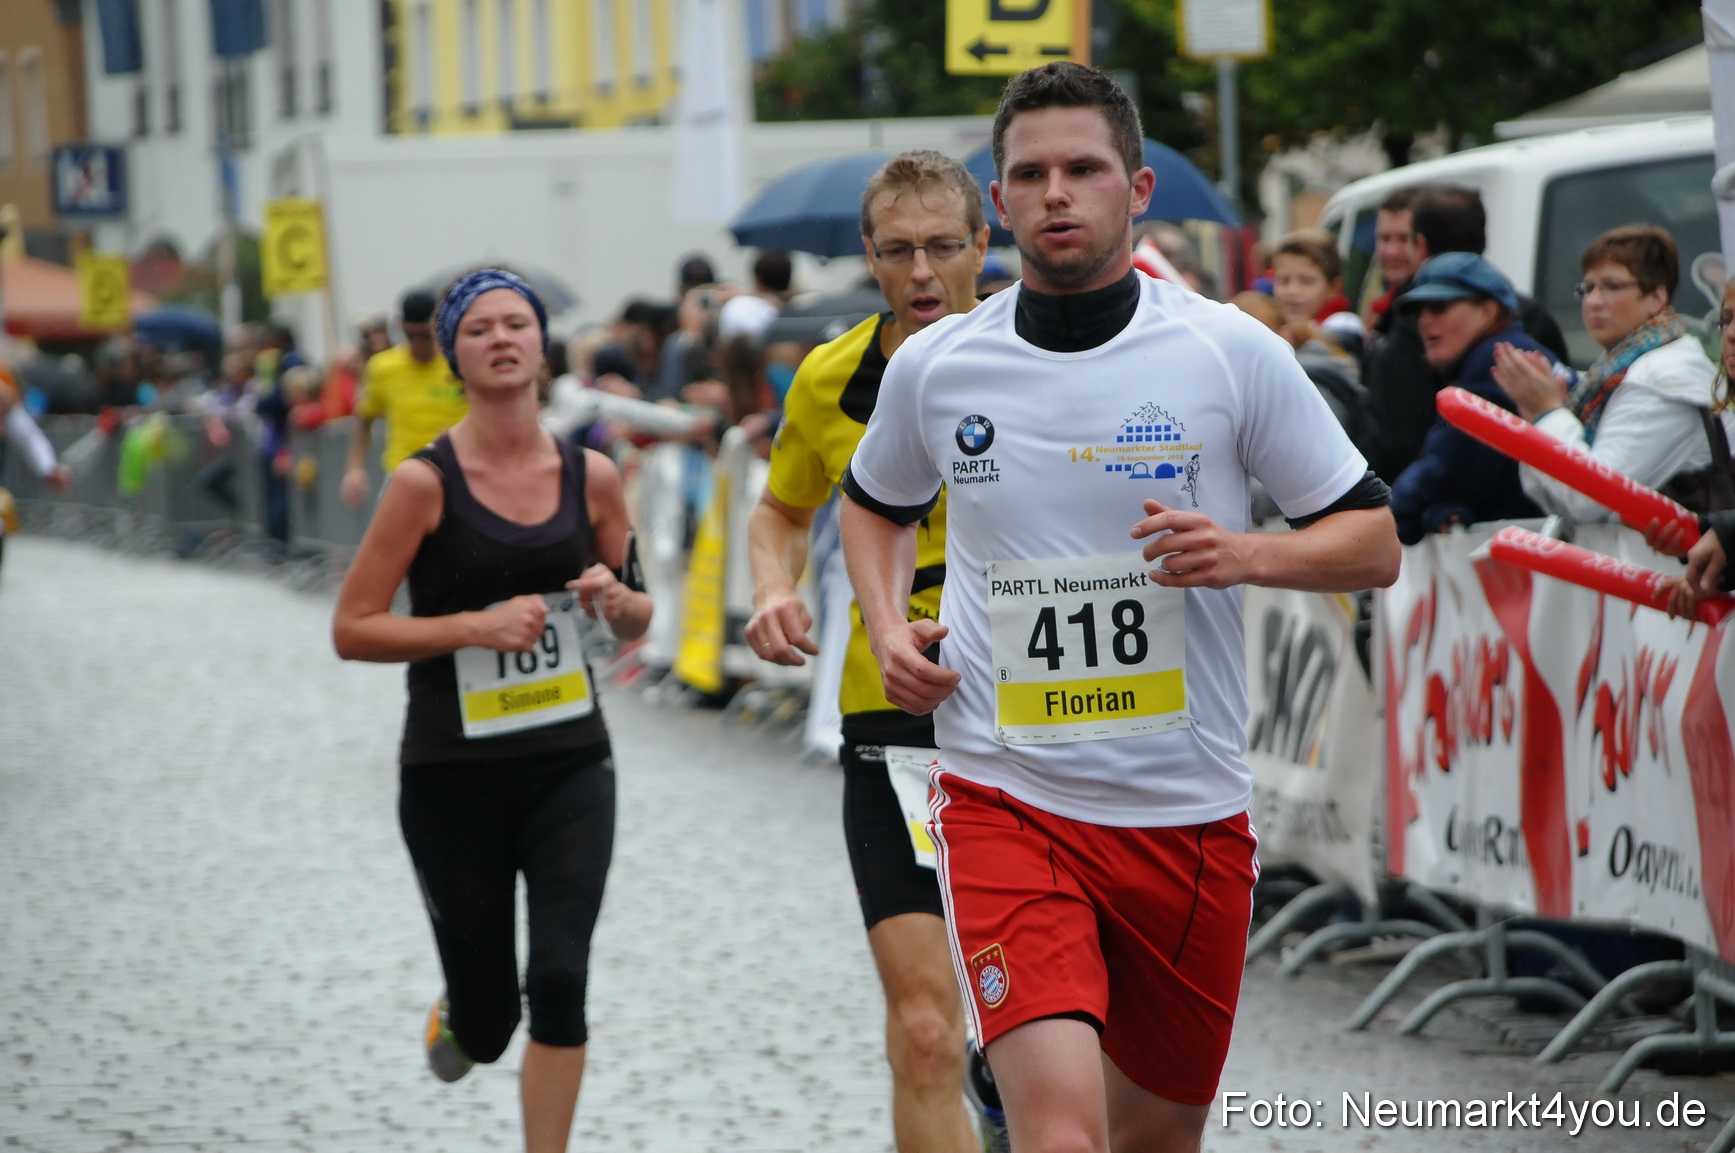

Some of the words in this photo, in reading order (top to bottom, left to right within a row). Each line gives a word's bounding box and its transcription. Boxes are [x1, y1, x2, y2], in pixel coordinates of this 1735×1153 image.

[959, 416, 991, 430] BMW
[1067, 446, 1101, 462] 14.
[1096, 444, 1156, 454] Neumarkter
[1159, 443, 1203, 452] Stadtlauf
[952, 458, 1001, 475] PARTL
[953, 473, 1001, 485] Neumarkt
[991, 578, 1049, 596] PARTL
[1054, 572, 1148, 594] Neumarkt
[1027, 598, 1149, 671] 418
[499, 685, 561, 712] Simone
[1045, 687, 1136, 717] Florian
